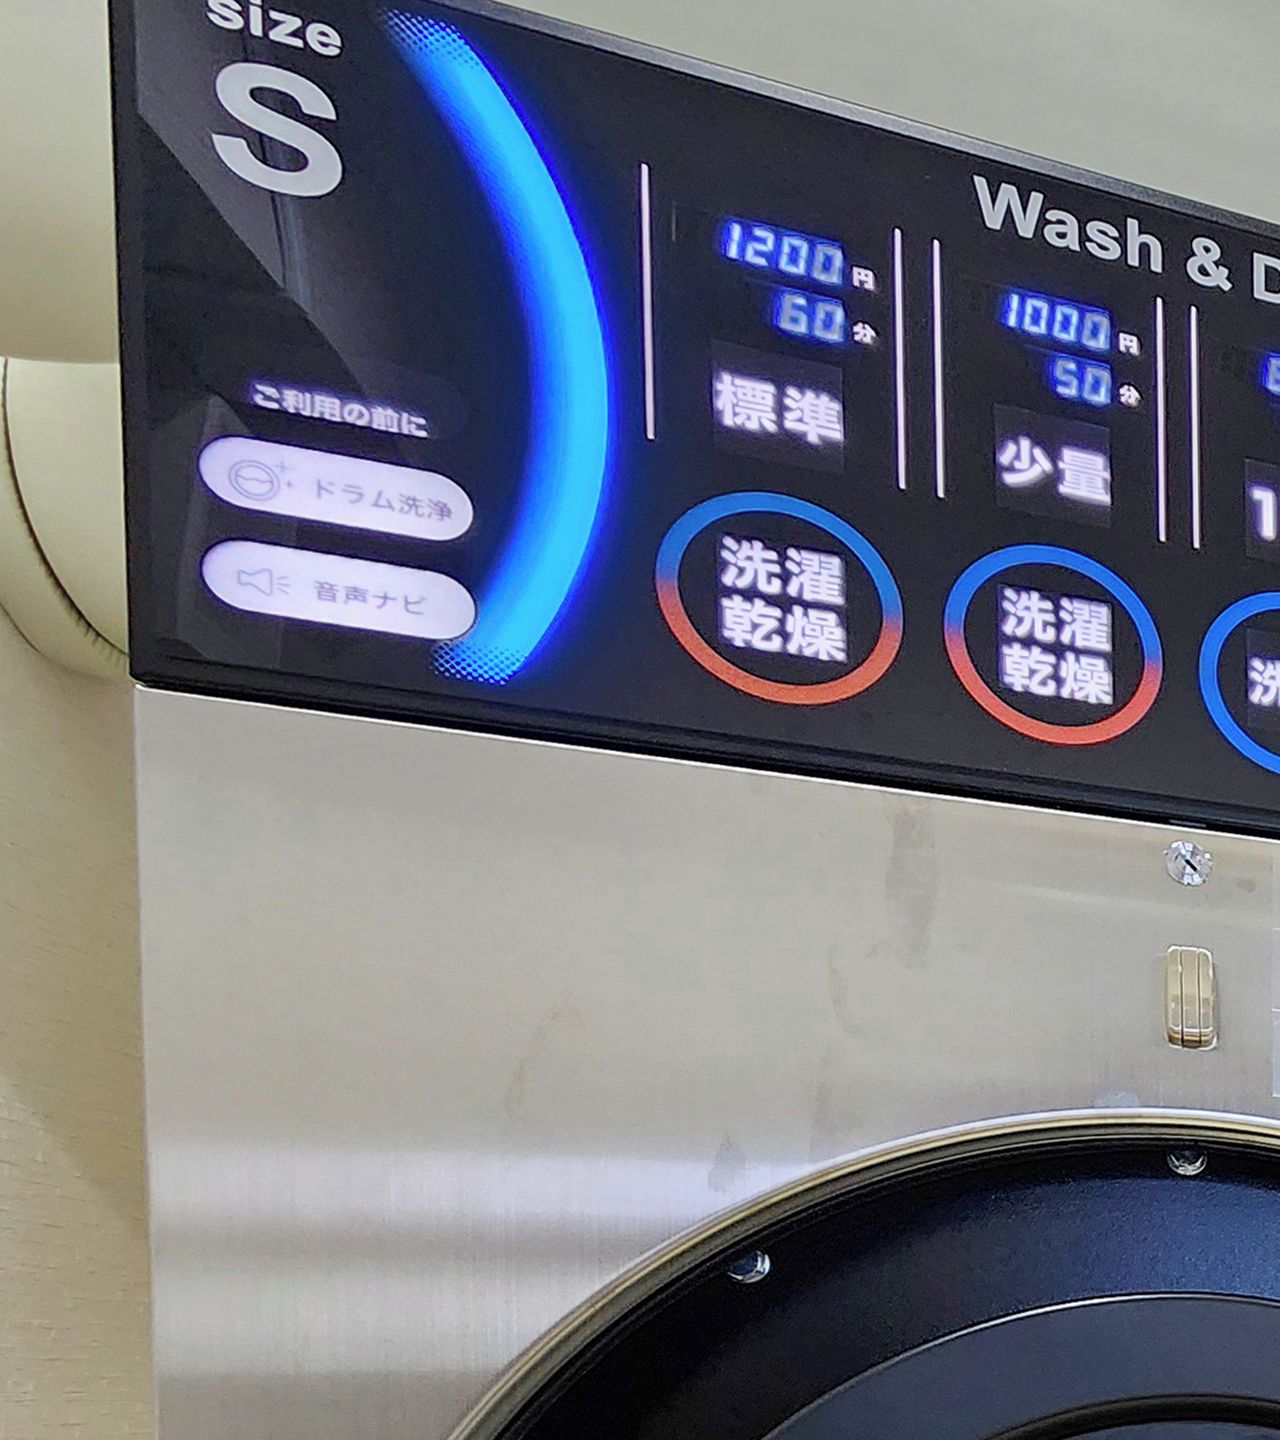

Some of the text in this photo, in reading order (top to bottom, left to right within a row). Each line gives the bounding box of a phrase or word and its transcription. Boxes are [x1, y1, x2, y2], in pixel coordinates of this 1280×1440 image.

[206, 0, 342, 57] size
[211, 62, 343, 197] S
[722, 220, 876, 291] 1200 円
[973, 173, 1163, 273] Wash
[1186, 235, 1233, 292] &
[776, 290, 878, 345] 60 分
[1003, 292, 1142, 357] 1000 円
[252, 382, 429, 439] ご利用の前に
[714, 374, 844, 446] 標準
[1052, 357, 1143, 408] 50 分
[312, 476, 453, 525] ドラム洗浄
[999, 436, 1113, 507] 少量
[312, 578, 428, 619] 音声ナビ
[719, 532, 846, 607] 洗濯
[720, 594, 847, 663] 乾燥
[1001, 586, 1113, 654] 洗濯
[1001, 641, 1114, 706] 乾燥
